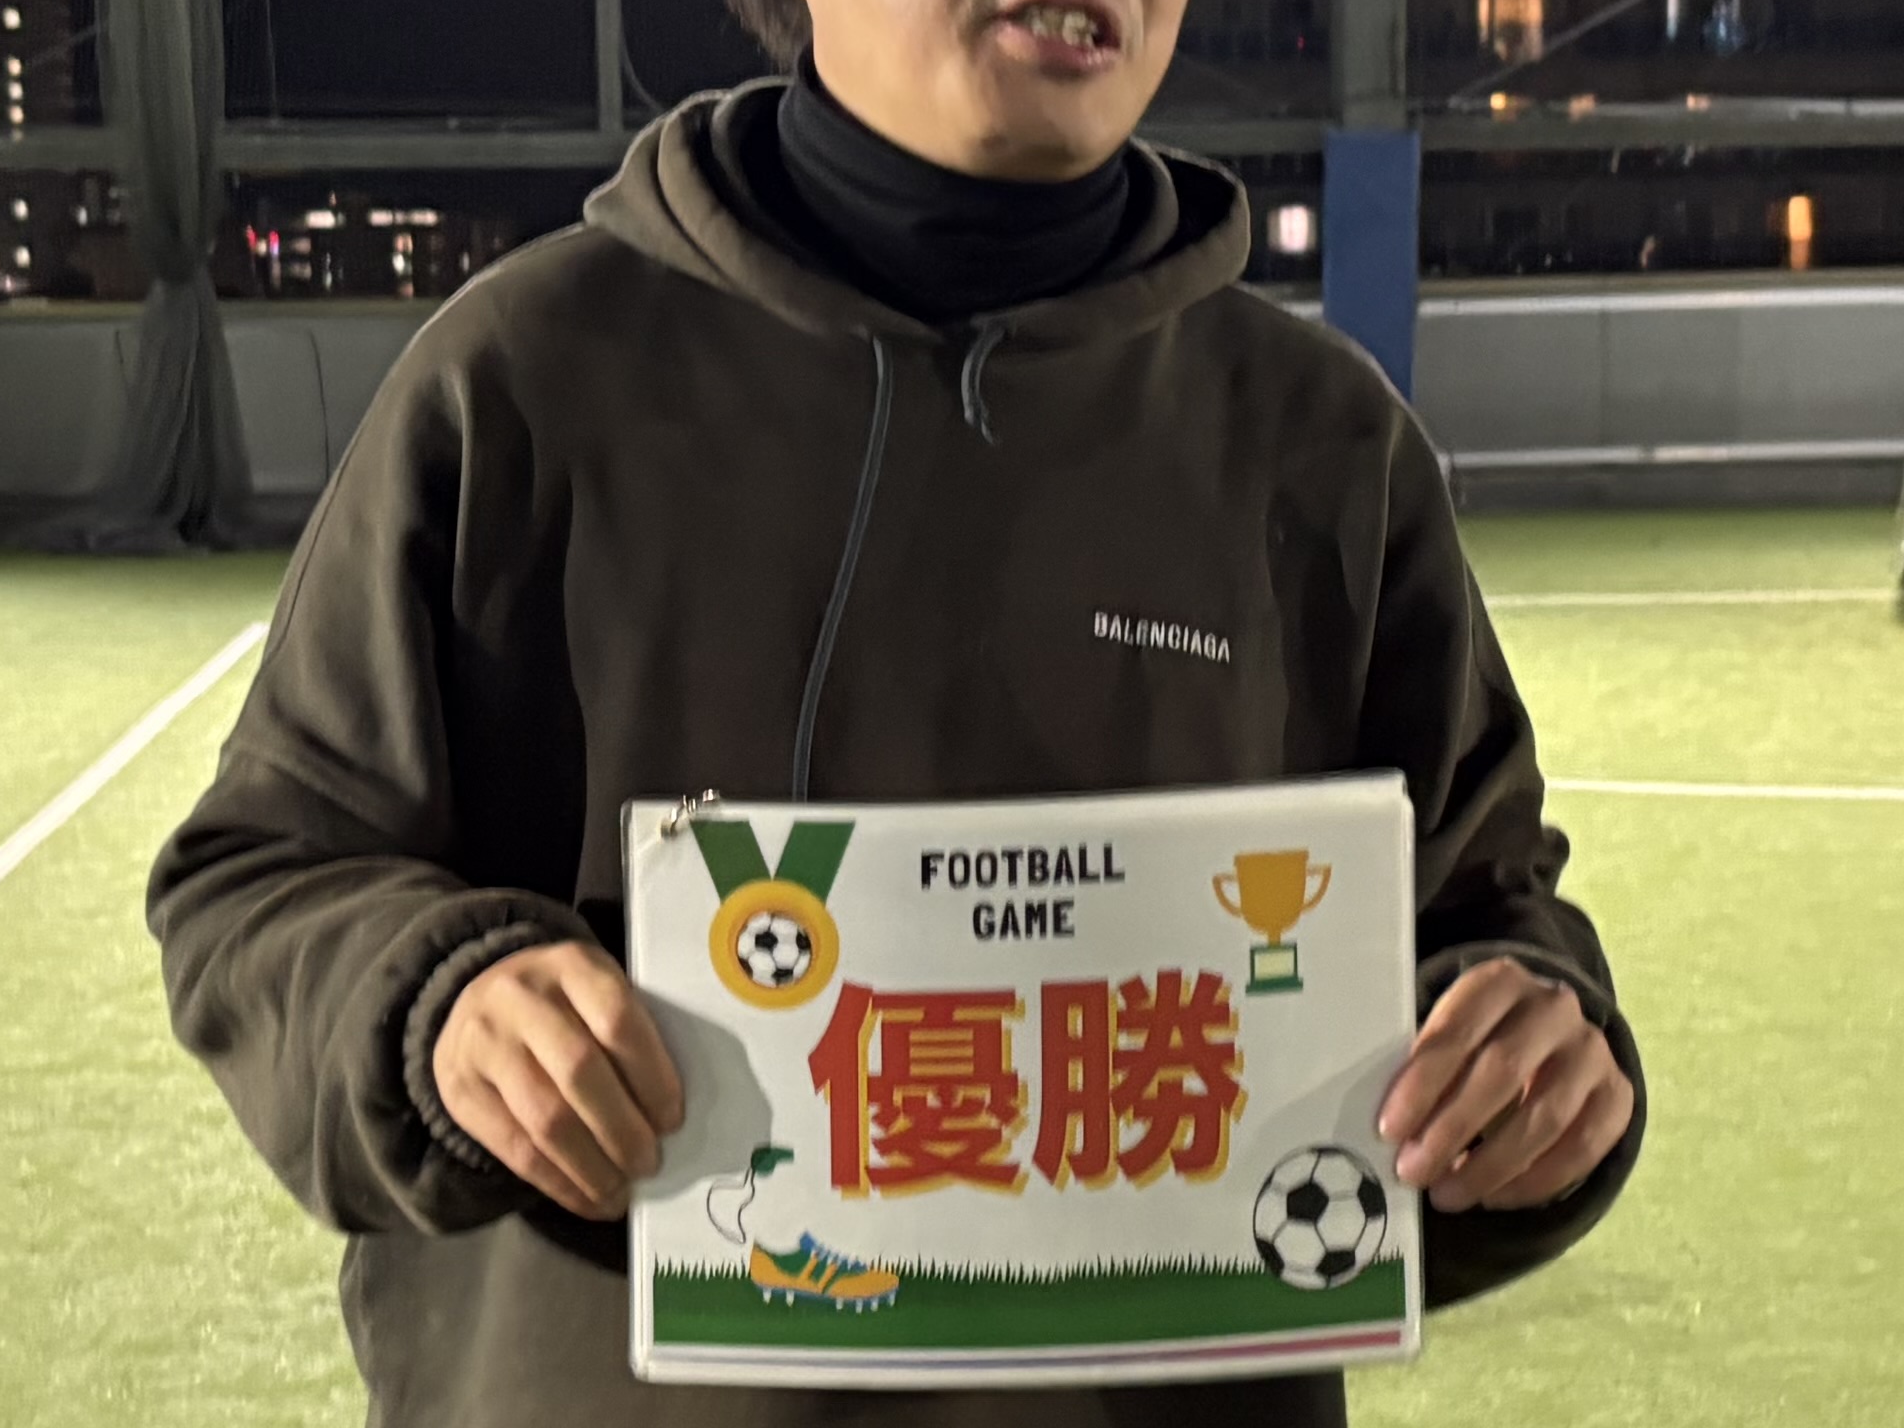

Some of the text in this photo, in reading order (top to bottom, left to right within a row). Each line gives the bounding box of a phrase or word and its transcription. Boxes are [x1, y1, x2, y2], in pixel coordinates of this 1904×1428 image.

[920, 843, 1126, 890] FOOTBALL
[972, 897, 1076, 941] GAME
[807, 968, 1249, 1201] 優勝
